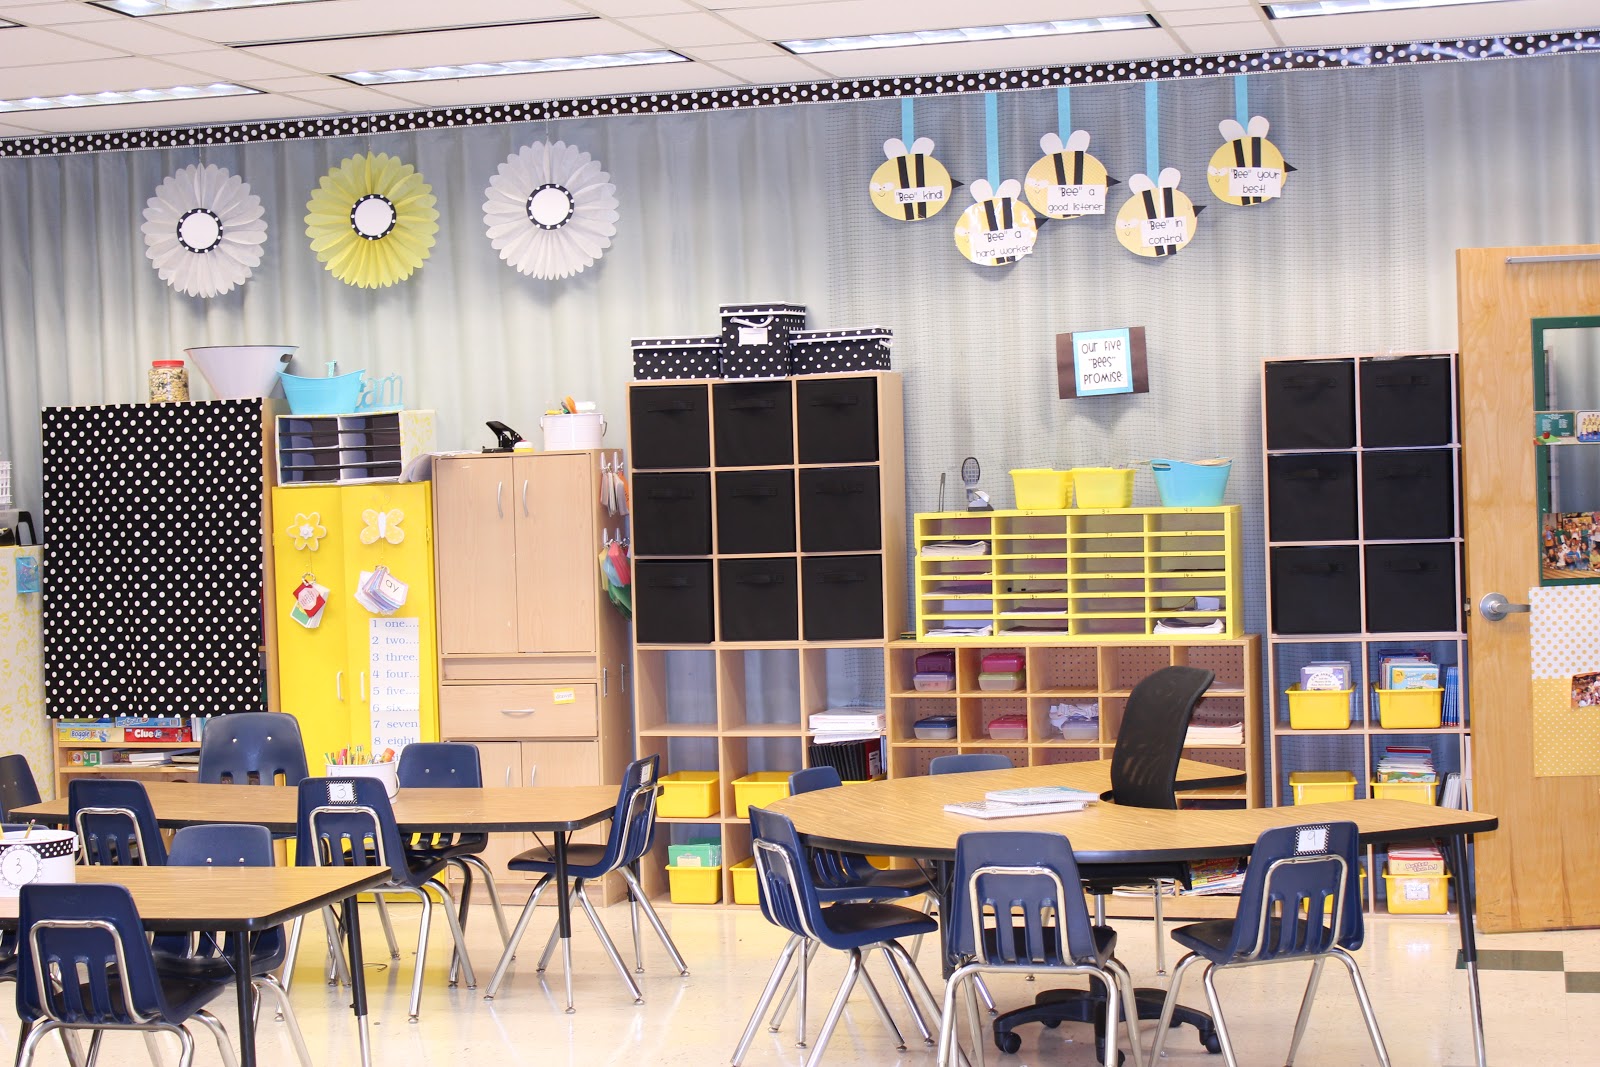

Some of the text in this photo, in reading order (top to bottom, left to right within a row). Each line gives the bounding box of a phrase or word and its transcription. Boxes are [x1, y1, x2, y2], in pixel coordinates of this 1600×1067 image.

[1257, 171, 1280, 181] your
[1089, 188, 1095, 196] a
[1048, 203, 1069, 213] good
[1174, 219, 1183, 228] in
[1014, 230, 1022, 239] a
[1148, 234, 1183, 246] control
[975, 247, 996, 258] hard
[385, 579, 400, 593] ay
[373, 620, 377, 628] 1
[372, 636, 379, 645] 2
[372, 653, 379, 661] 3
[373, 669, 380, 678] 4
[373, 686, 380, 695] 5
[373, 704, 380, 712] 6
[374, 720, 380, 729] 7
[134, 729, 154, 739] Clue
[374, 736, 381, 745] 8
[336, 784, 347, 799] 3
[1307, 830, 1316, 847] 9
[15, 857, 23, 874] 3
